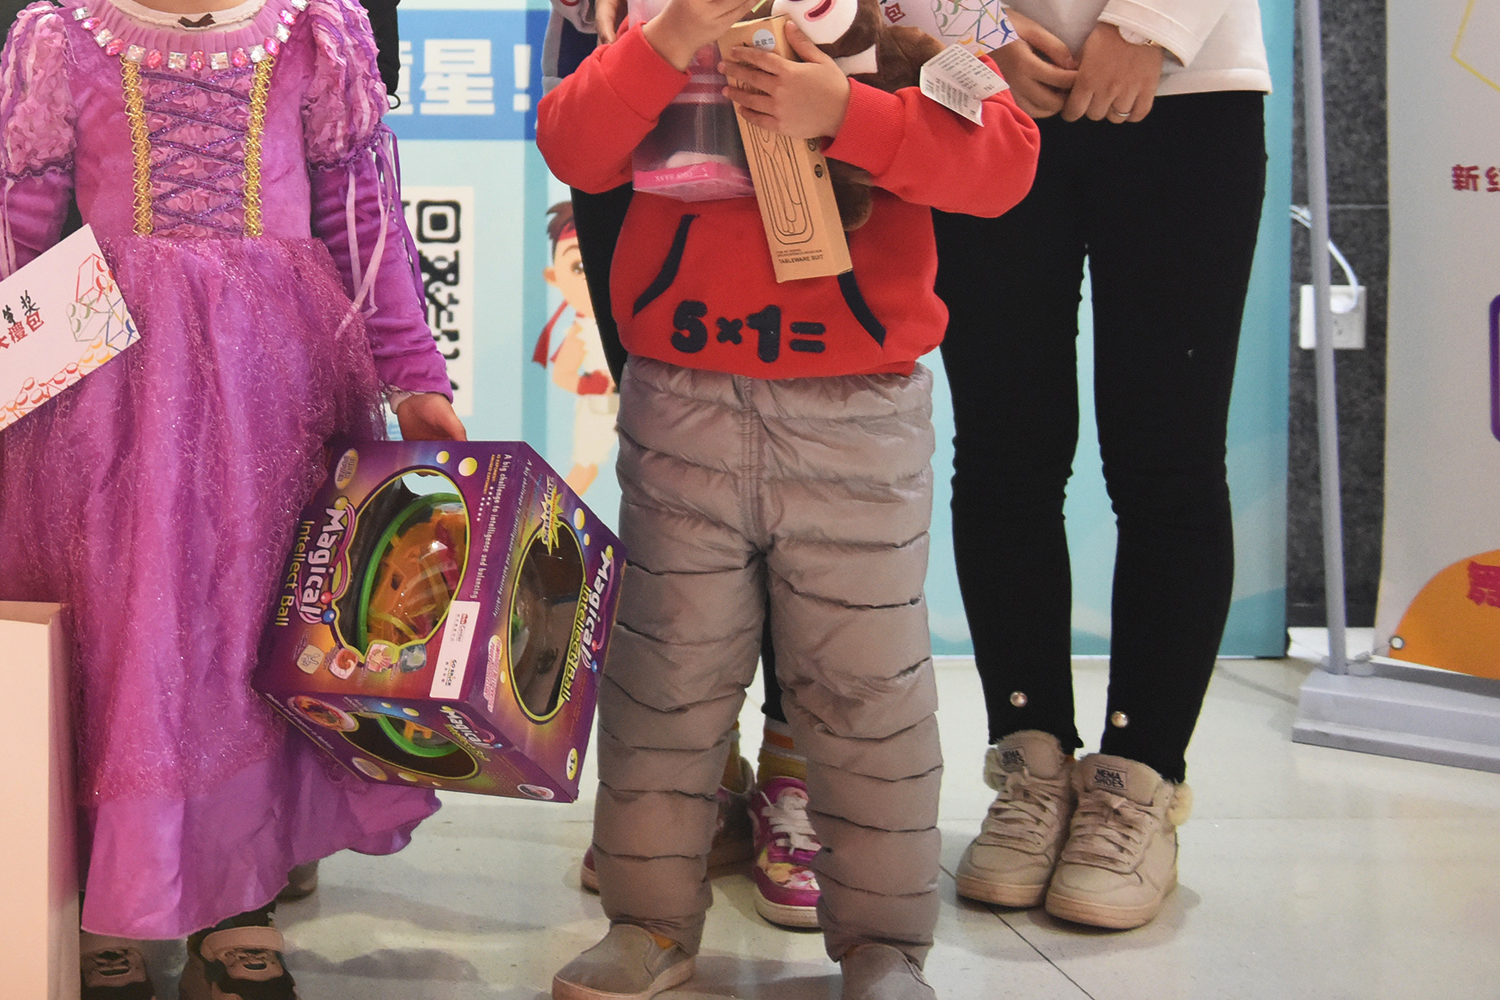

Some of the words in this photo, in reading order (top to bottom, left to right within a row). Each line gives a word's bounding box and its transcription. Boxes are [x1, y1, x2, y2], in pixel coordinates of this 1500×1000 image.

[884, 2, 906, 24] 包
[491, 473, 507, 503] challenge
[482, 513, 498, 551] intelligence
[284, 520, 315, 591] Intellect
[300, 508, 348, 615] Magical
[469, 567, 486, 599] balancing
[275, 595, 295, 626] Ball
[569, 585, 592, 661] Intellect
[581, 551, 612, 661] Magical
[562, 658, 585, 702] Ball
